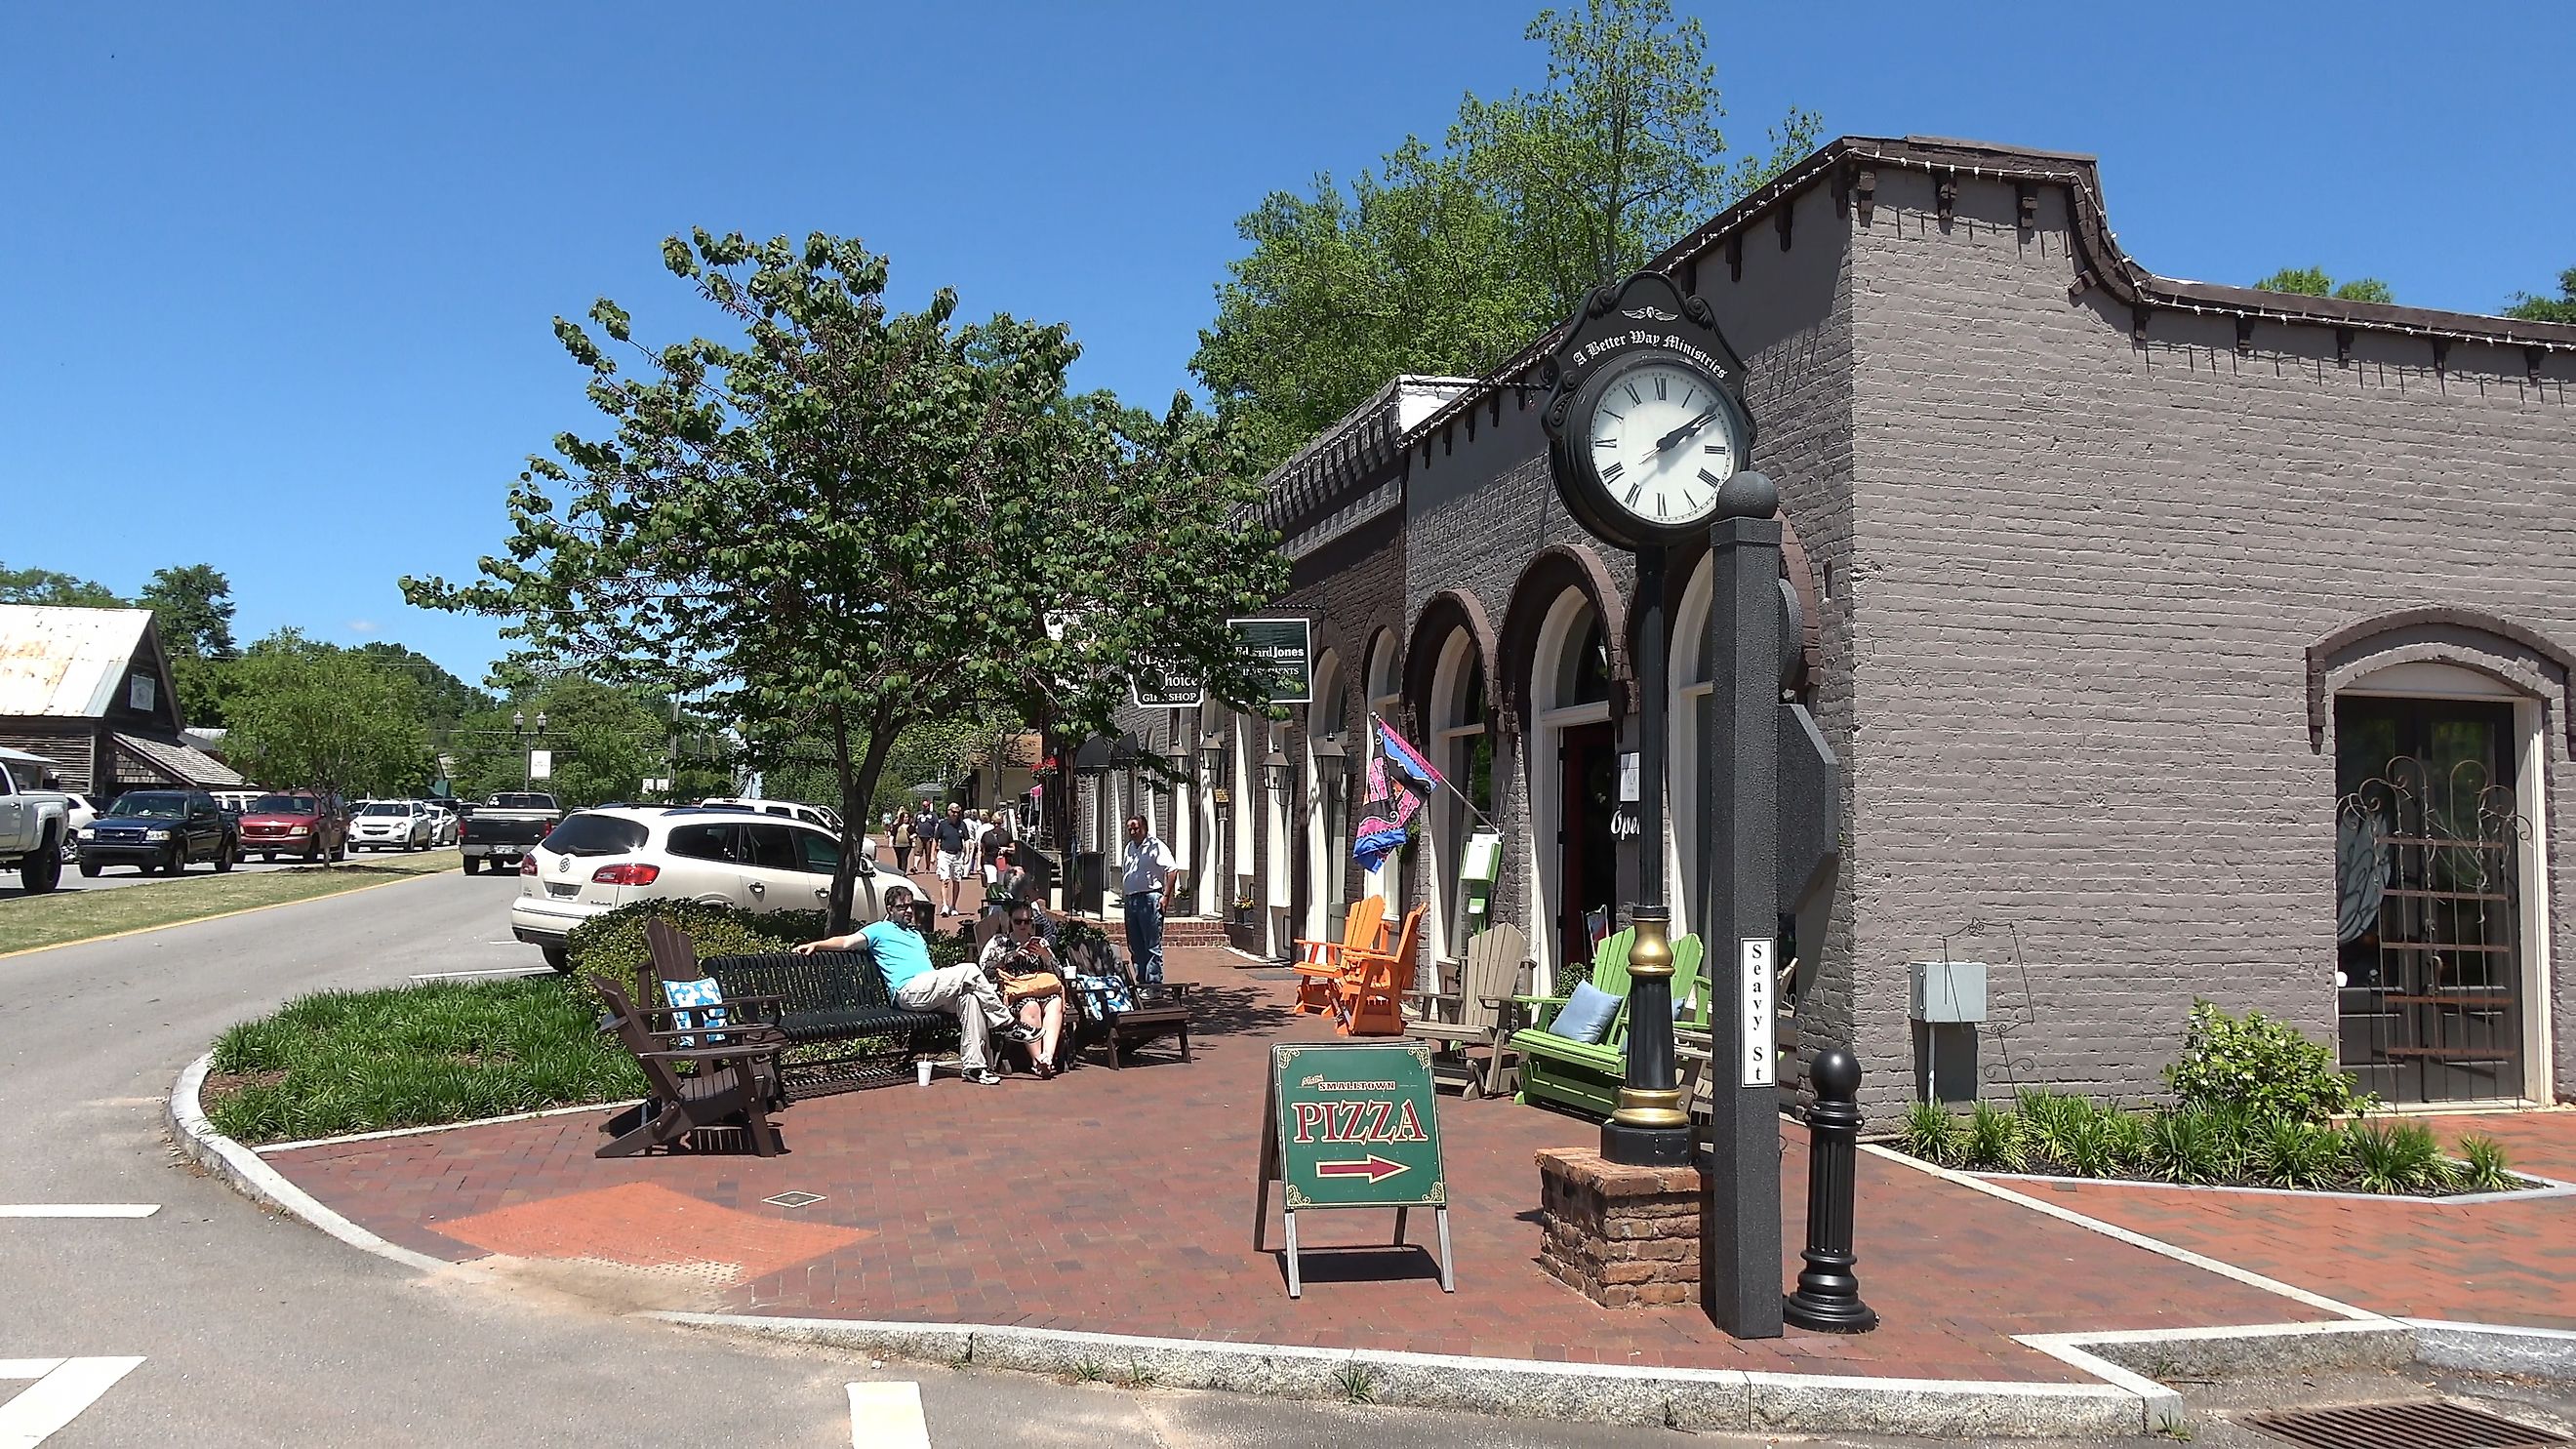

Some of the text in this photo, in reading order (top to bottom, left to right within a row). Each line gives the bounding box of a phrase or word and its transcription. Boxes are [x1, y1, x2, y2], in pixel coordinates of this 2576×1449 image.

[1573, 329, 1728, 379] A Better Way Ministries
[1624, 382, 1642, 408] XI
[1654, 377, 1667, 401] XII
[1594, 436, 1617, 449] IX
[1704, 445, 1726, 455] III
[1624, 481, 1642, 507] VII
[1657, 492, 1668, 516] VI
[1234, 645, 1305, 659] Edard Jones
[1168, 692, 1197, 702] SHOP
[1751, 944, 1763, 1080] Seavy St
[1318, 1081, 1396, 1092] SMALLTOWN
[1291, 1099, 1429, 1146] PIZZA
